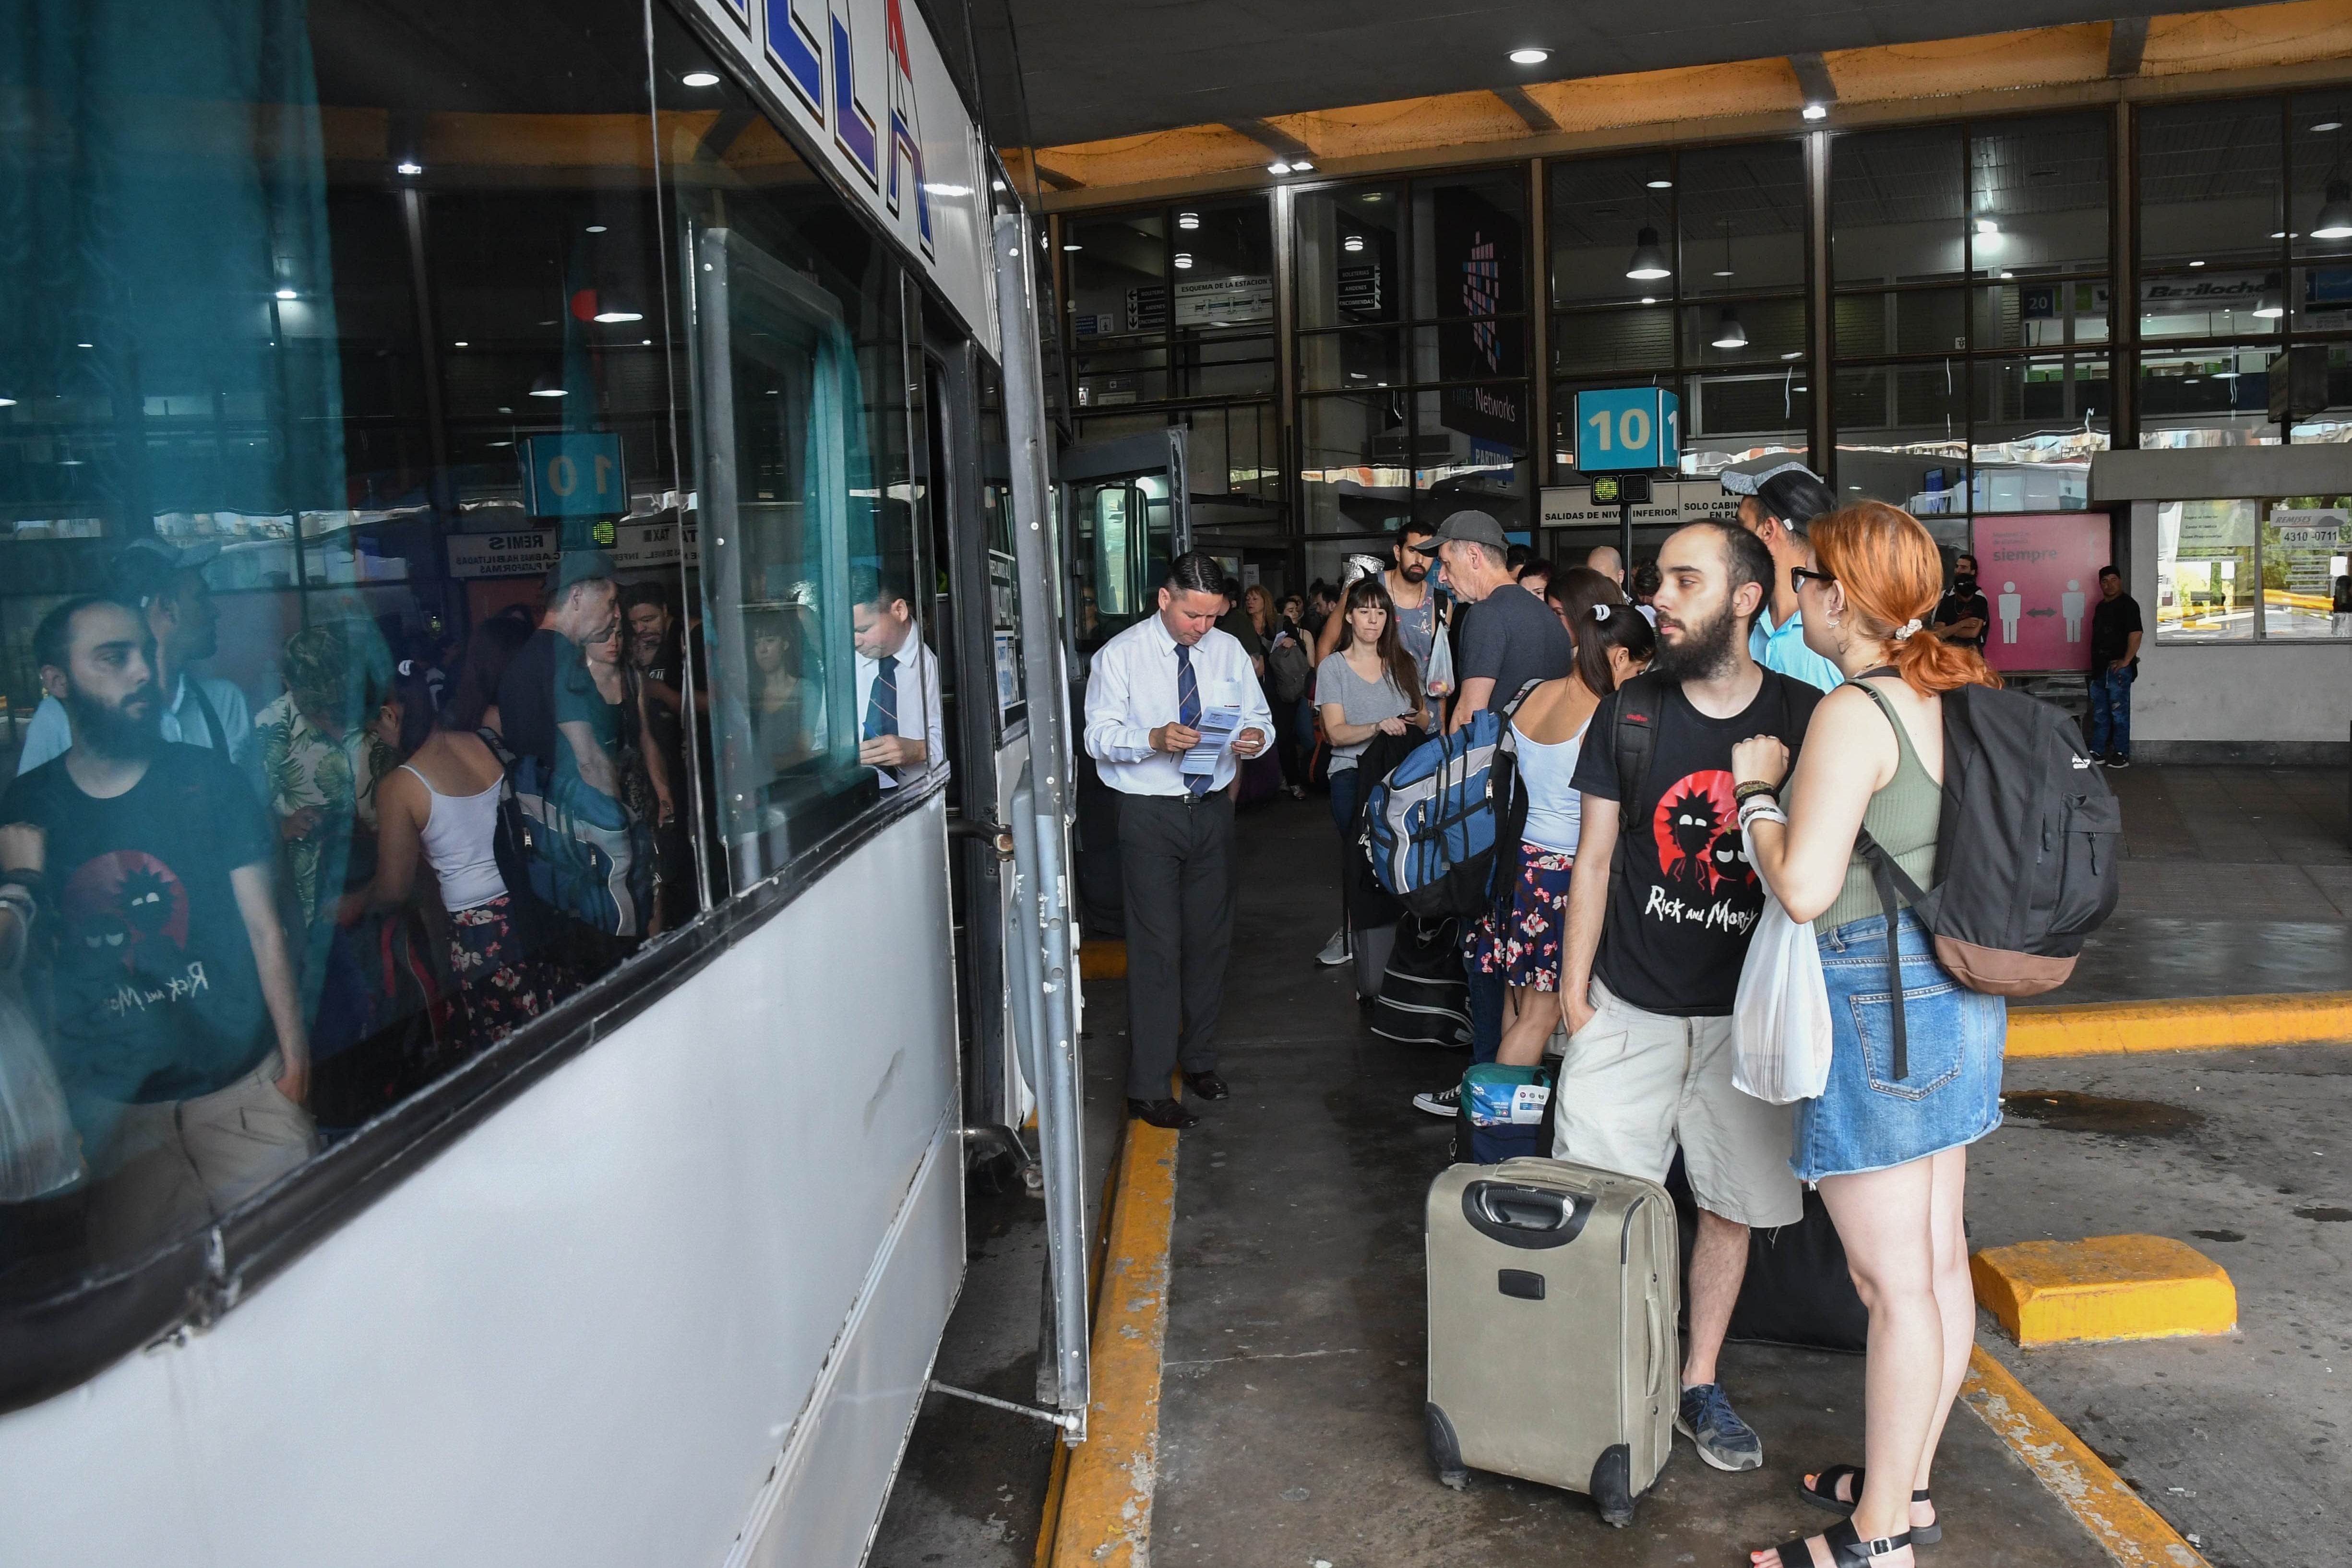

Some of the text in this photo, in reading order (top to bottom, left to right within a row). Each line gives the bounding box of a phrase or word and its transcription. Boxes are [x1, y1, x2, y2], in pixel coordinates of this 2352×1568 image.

[1181, 284, 1214, 292] ESQUEMA
[1235, 279, 1267, 287] ESTACION
[2028, 296, 2048, 310] 20
[1475, 387, 1516, 423] Networks
[1588, 408, 1650, 451] 10
[1667, 410, 1678, 451] 1
[1684, 501, 1740, 511] SOLO CABIN
[1545, 512, 1584, 521] SALIDAS
[1633, 508, 1678, 518] INFERIOR
[2284, 531, 2337, 541] 4310 -0711
[1993, 547, 2057, 563] siempre
